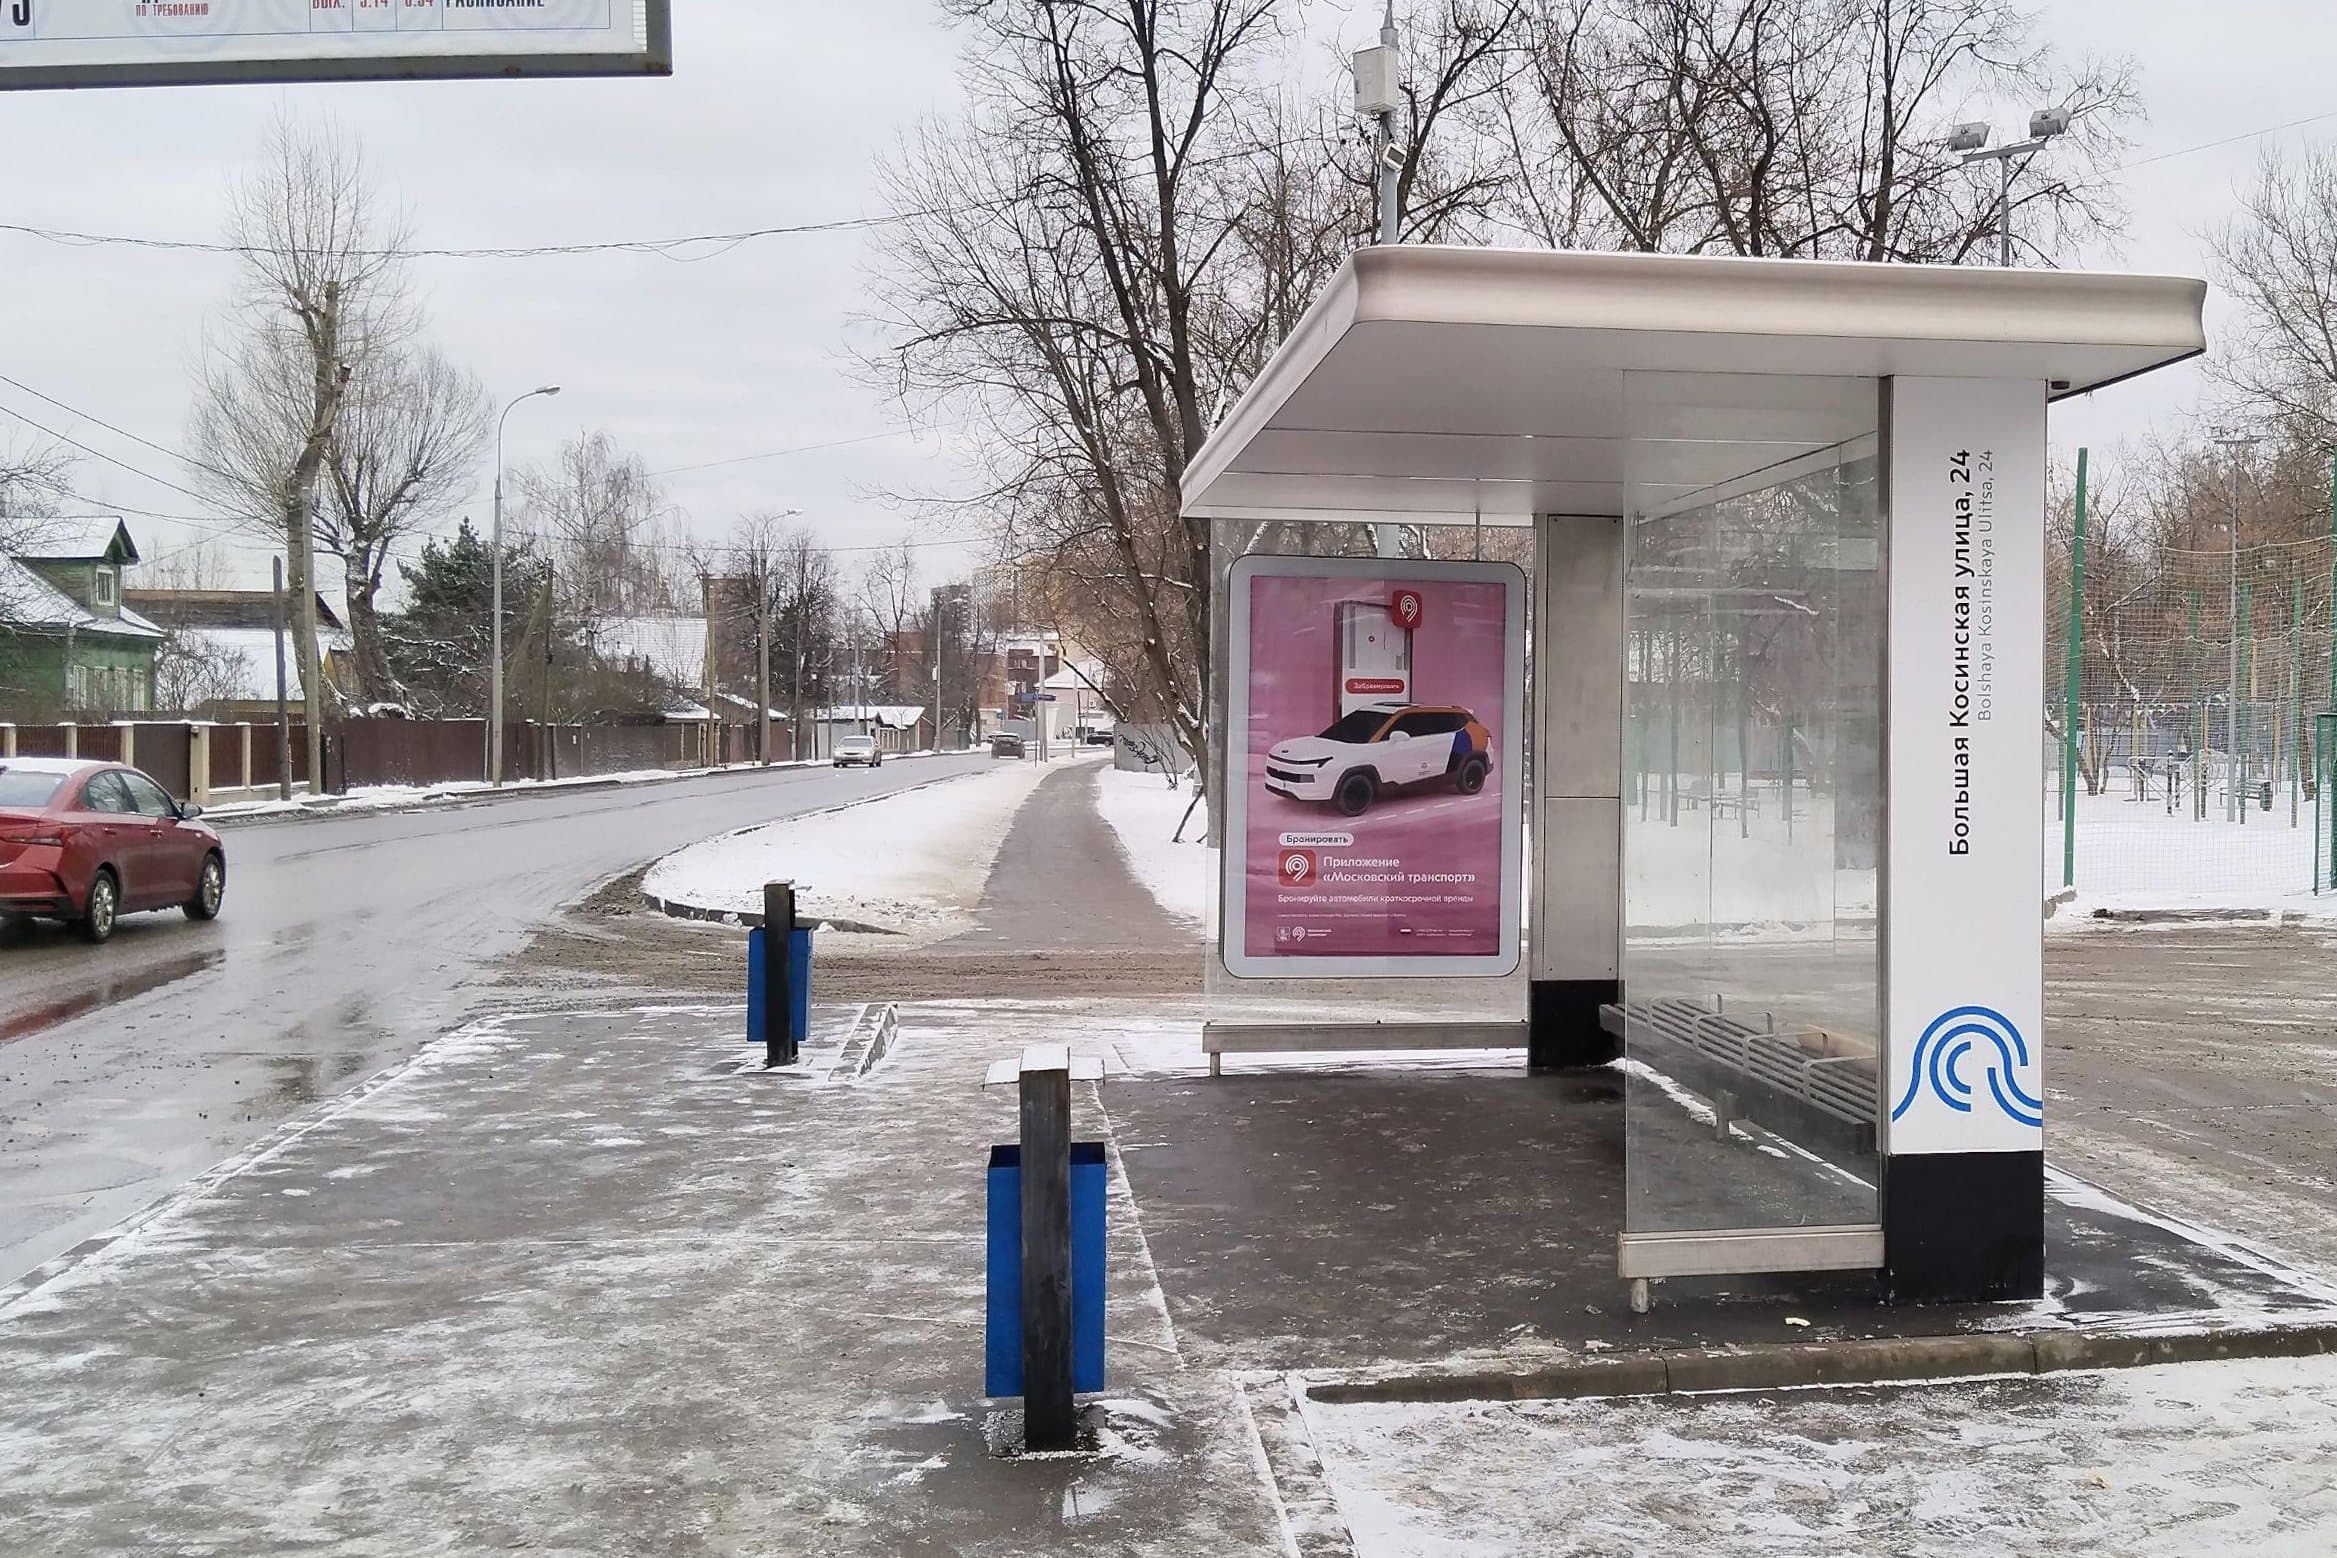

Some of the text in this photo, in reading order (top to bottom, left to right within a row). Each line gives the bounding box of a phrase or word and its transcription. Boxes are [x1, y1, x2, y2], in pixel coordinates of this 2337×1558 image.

[135, 3, 209, 17] ПО ТРЕБОВАНИЮ
[1977, 450, 1996, 721] Bolshaya Kosinskaya Ulitsa, 24
[1948, 449, 1976, 855] Большая Косинская улица, 24
[1286, 834, 1349, 844] Бронировать
[1323, 856, 1400, 870] Приложение
[1323, 871, 1476, 885] «Московский транспорт»
